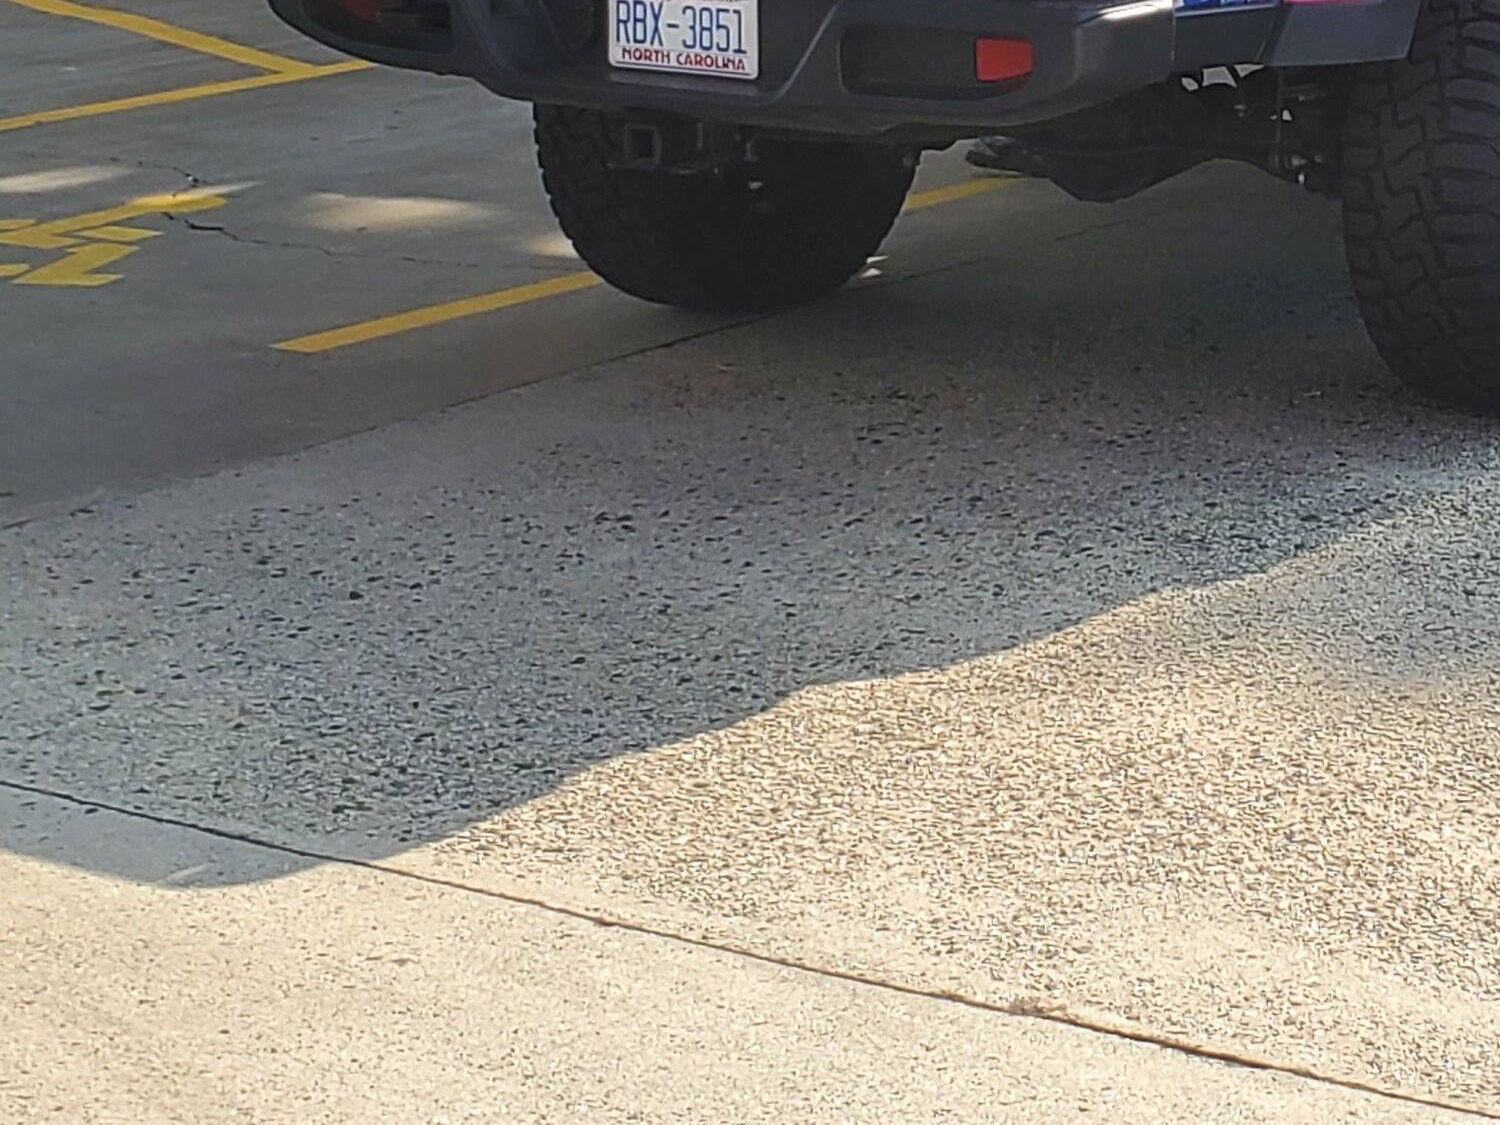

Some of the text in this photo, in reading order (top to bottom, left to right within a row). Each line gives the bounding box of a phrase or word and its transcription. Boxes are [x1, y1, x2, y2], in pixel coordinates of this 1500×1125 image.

[616, 0, 748, 55] RBX-3851
[621, 47, 746, 71] NORTH CAROLINA
